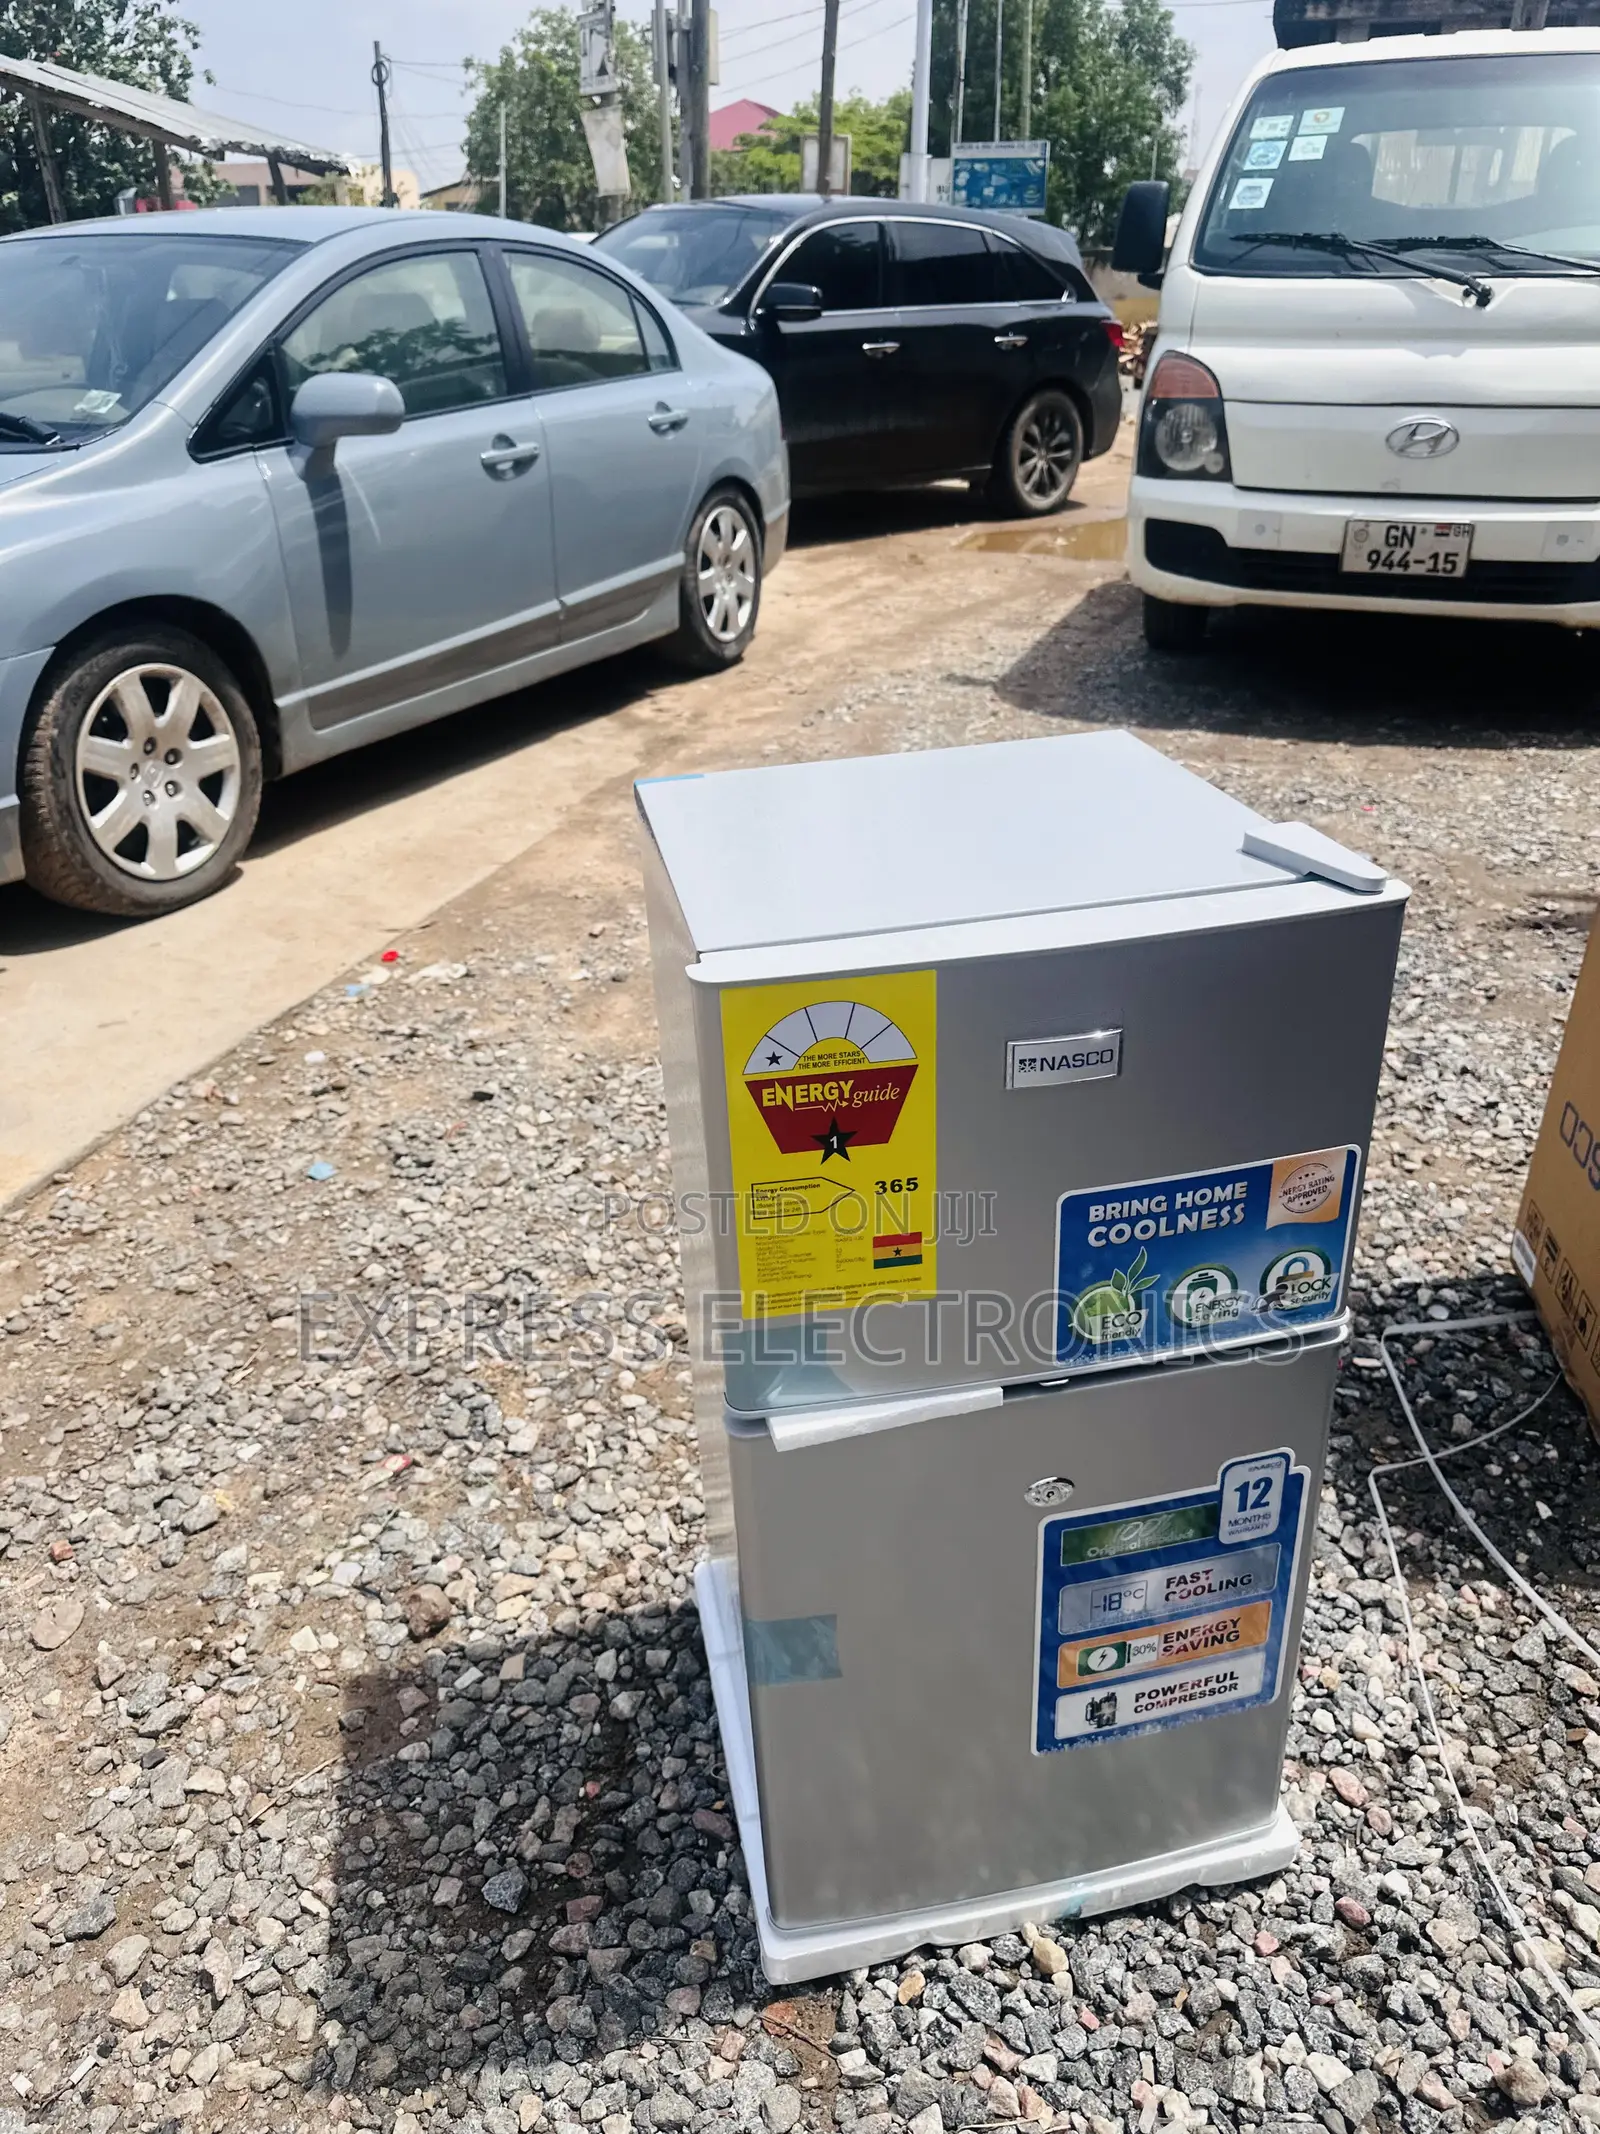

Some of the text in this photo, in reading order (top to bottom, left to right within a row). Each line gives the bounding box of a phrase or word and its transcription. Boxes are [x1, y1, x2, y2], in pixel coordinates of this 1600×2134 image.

[1384, 525, 1416, 548] GN
[1366, 549, 1459, 574] 944-15
[798, 1058, 866, 1070] THE MORE EFFICIENT
[817, 1053, 838, 1061] MORE
[1040, 1049, 1114, 1072] NASCO
[761, 1080, 900, 1112] ENERGY guide
[829, 1135, 838, 1149] 1
[756, 1183, 821, 1196] Energy Consumption
[874, 1176, 919, 1195] 365
[1307, 1174, 1336, 1189] RATING
[1088, 1181, 1248, 1223] BRING HOME
[1287, 1184, 1328, 1204] APPROVED
[1087, 1202, 1247, 1249] COOLNESS
[1291, 1276, 1332, 1296] LOCK
[1194, 1295, 1242, 1314] ENERGY
[1290, 1291, 1332, 1306] security
[1101, 1311, 1142, 1330] ECO
[1194, 1307, 1240, 1323] saving
[1101, 1327, 1141, 1342] friendly
[1234, 1477, 1273, 1513] 12
[1227, 1512, 1272, 1528] MONTHS
[1227, 1522, 1270, 1536] WARRANTY
[1164, 1573, 1253, 1603] COOLING
[1166, 1568, 1214, 1589] FAST
[1163, 1617, 1242, 1645] ENERGY
[1131, 1643, 1158, 1657] 30%
[1161, 1630, 1241, 1657] SAVING
[1134, 1670, 1239, 1703] POWERFUL
[1133, 1682, 1239, 1715] COMPRESSOR
